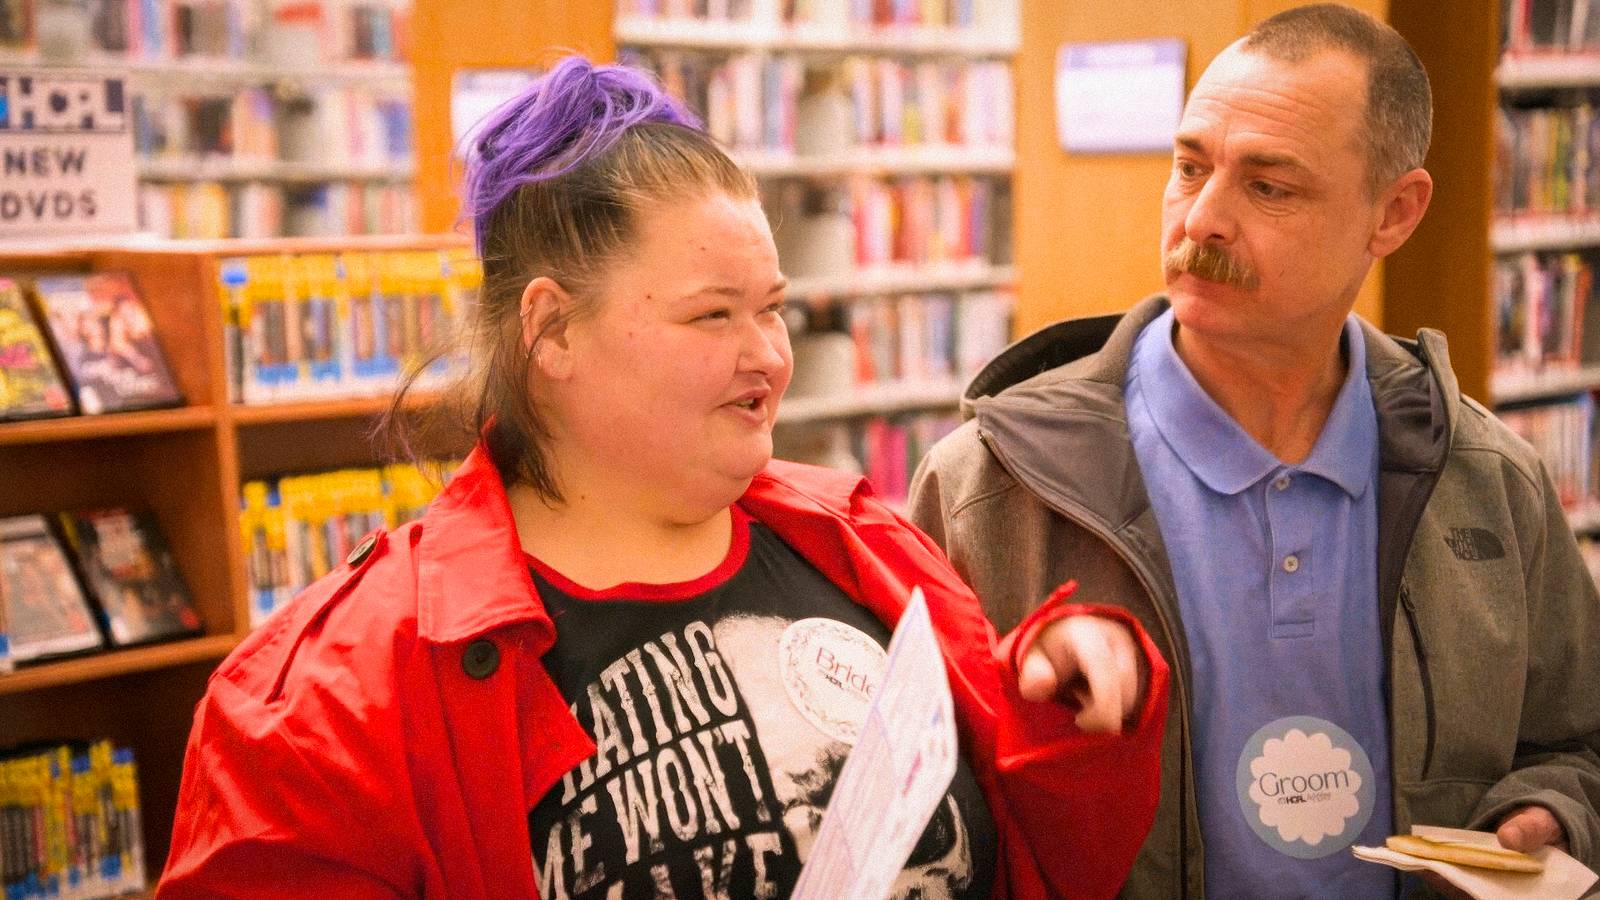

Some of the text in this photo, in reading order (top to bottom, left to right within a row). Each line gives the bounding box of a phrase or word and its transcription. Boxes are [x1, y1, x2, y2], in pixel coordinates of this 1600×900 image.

[4, 150, 86, 177] NEW
[0, 191, 98, 219] DVDS
[606, 719, 771, 866] WON'T
[1259, 769, 1349, 797] Groom
